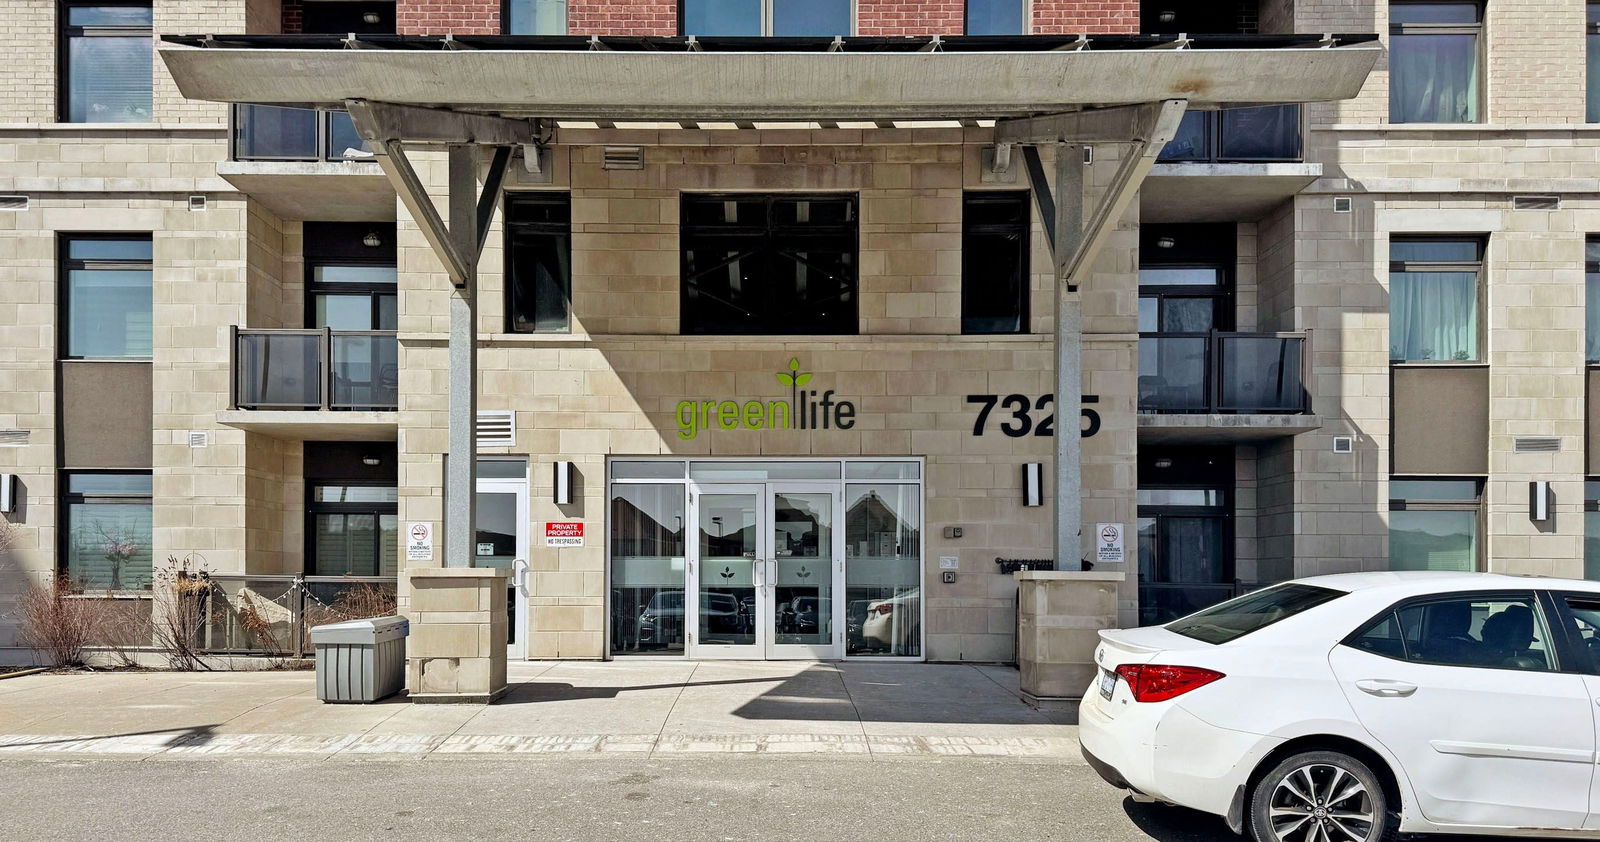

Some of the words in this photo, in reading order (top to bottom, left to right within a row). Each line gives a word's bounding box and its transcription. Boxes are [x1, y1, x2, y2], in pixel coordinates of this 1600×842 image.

[675, 399, 790, 440] green
[800, 390, 856, 430] life
[966, 393, 1101, 438] 7325
